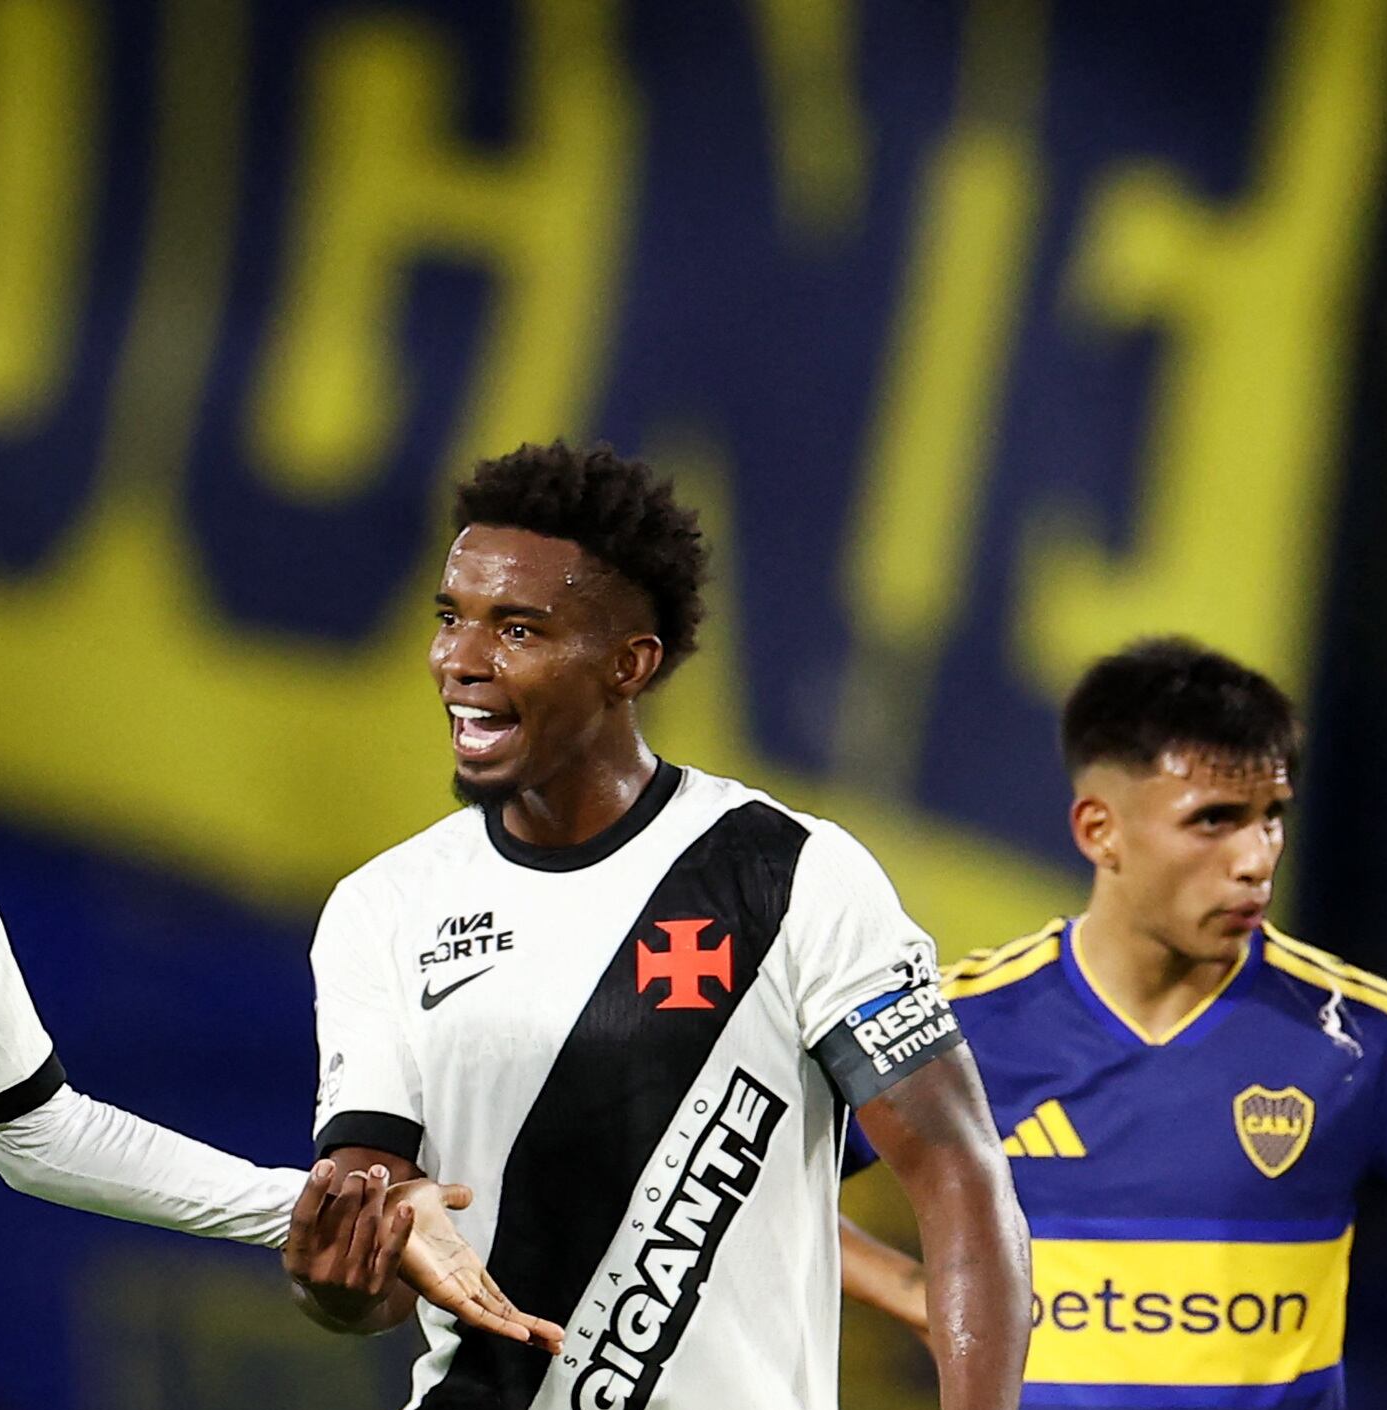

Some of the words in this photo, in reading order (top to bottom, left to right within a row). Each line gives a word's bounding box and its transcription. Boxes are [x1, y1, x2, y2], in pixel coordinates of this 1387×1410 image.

[871, 1050, 894, 1075] É
[564, 1270, 622, 1369] SEJA
[630, 1098, 709, 1232] SÓCIO
